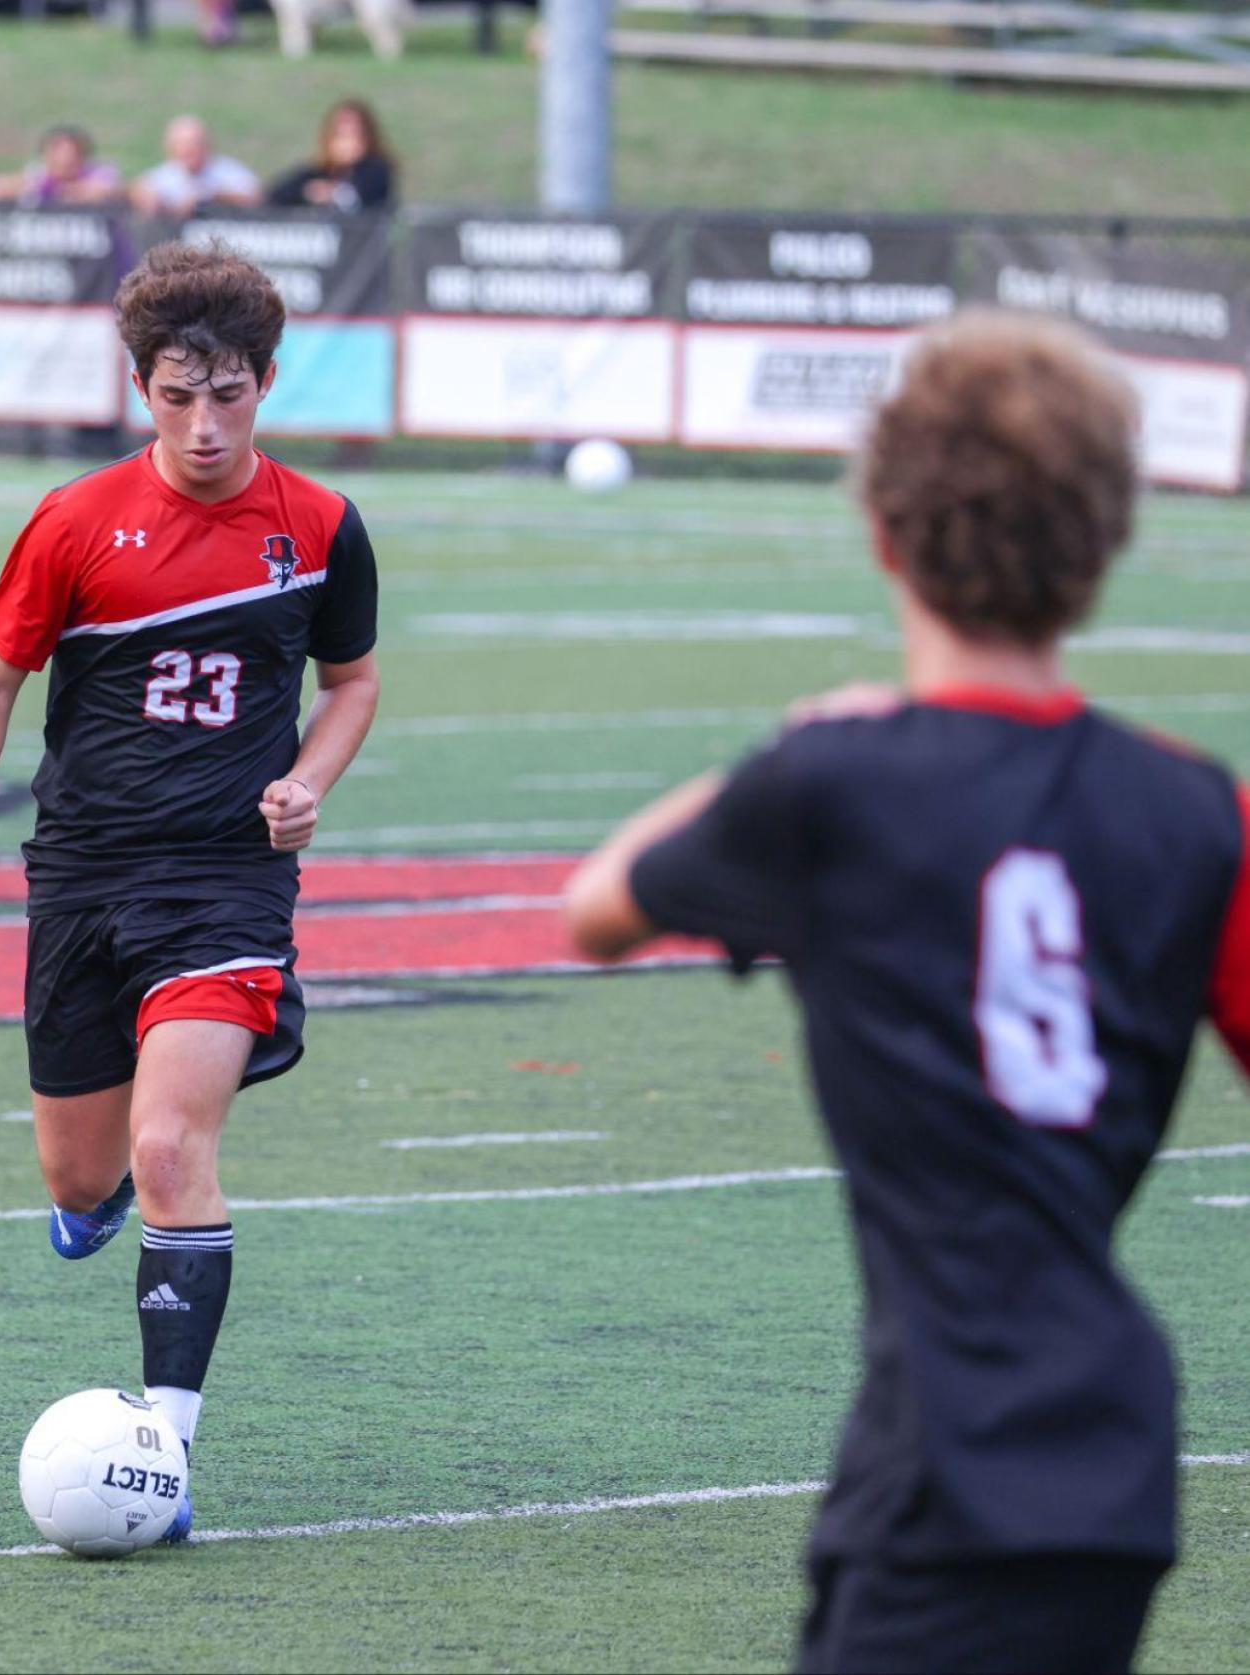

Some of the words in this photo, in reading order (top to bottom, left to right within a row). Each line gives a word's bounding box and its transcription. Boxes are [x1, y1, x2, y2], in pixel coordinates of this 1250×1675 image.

[143, 650, 243, 728] 23
[975, 847, 1108, 1126] 6
[140, 1299, 191, 1311] adidas
[136, 1426, 163, 1452] 10
[102, 1462, 180, 1500] SELECT
